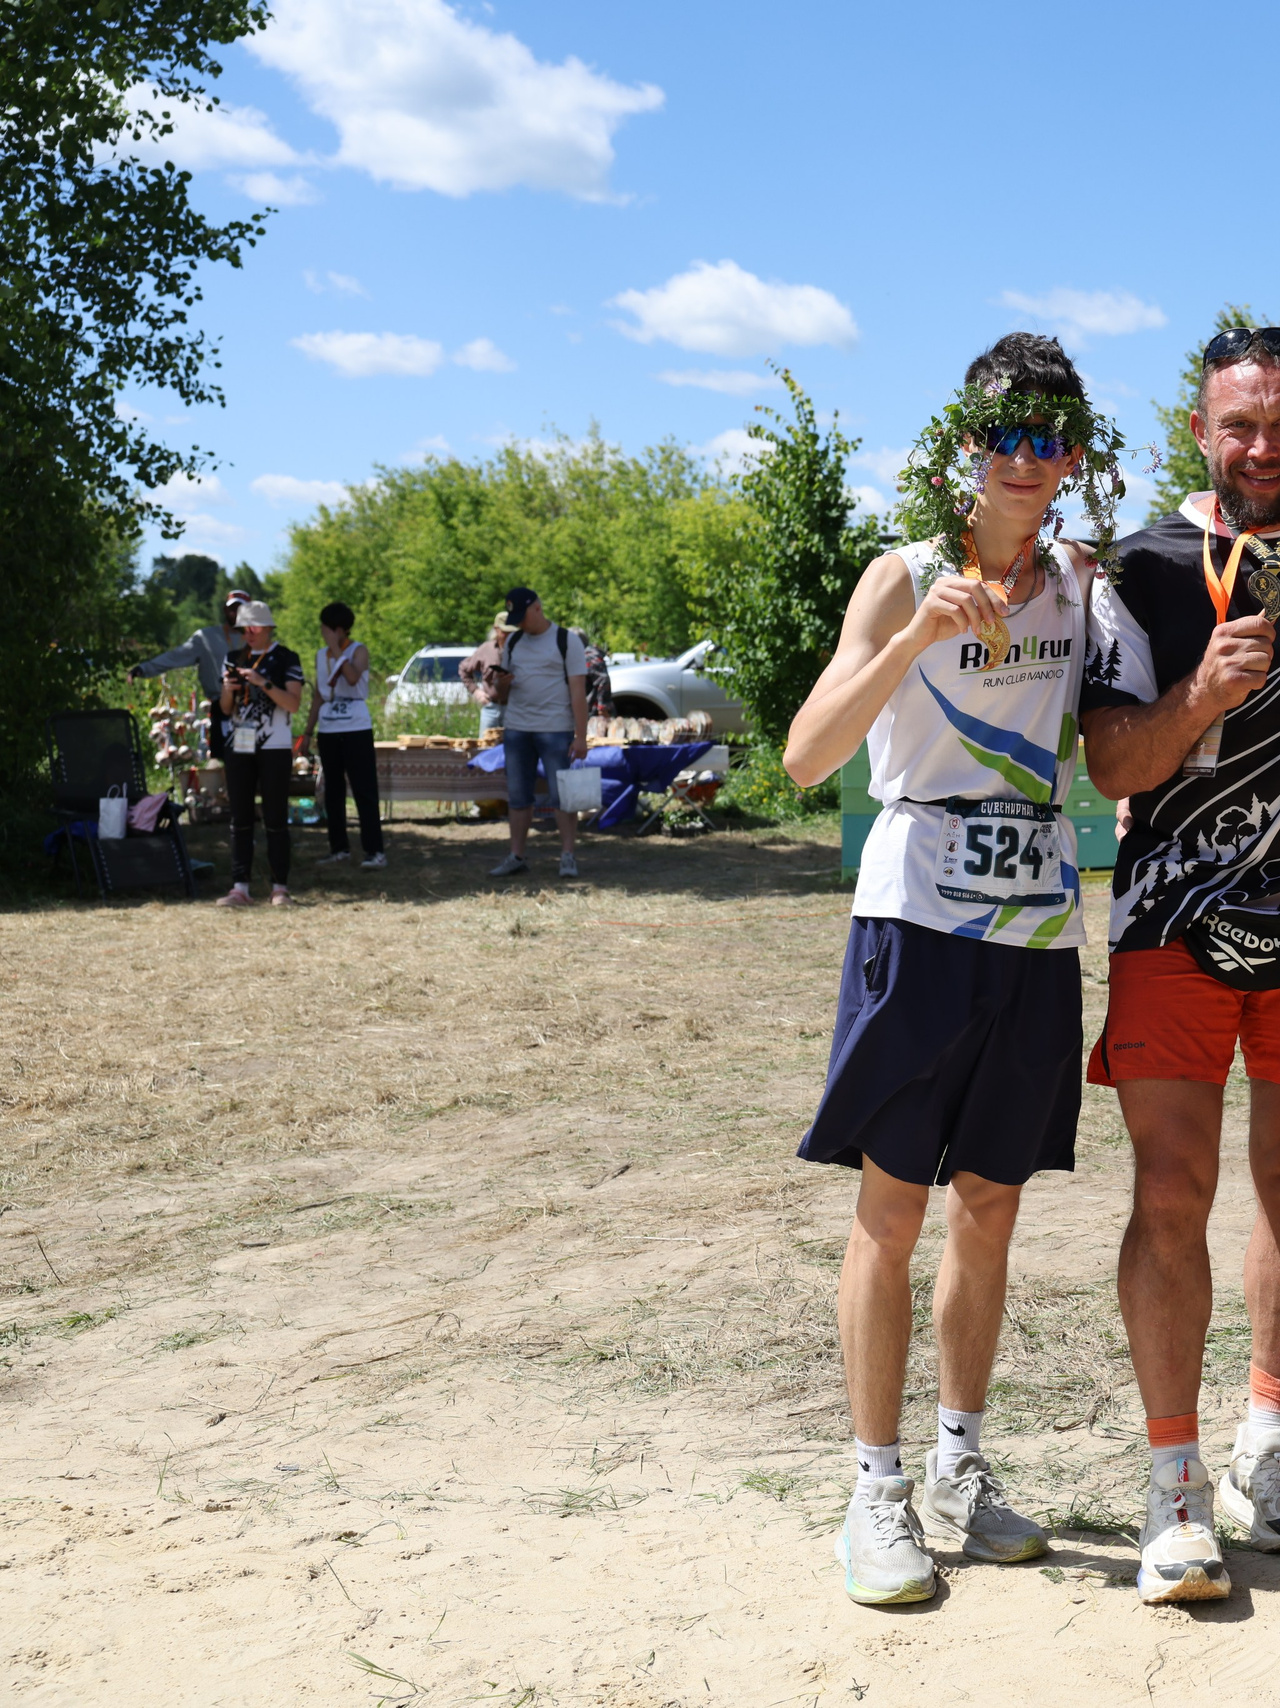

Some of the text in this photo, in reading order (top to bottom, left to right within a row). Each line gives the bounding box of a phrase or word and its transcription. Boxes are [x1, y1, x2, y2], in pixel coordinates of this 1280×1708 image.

[983, 677, 1004, 688] RUN
[1005, 672, 1027, 686] CLUB
[963, 824, 1043, 881] 524
[1113, 1041, 1146, 1052] Reebok
